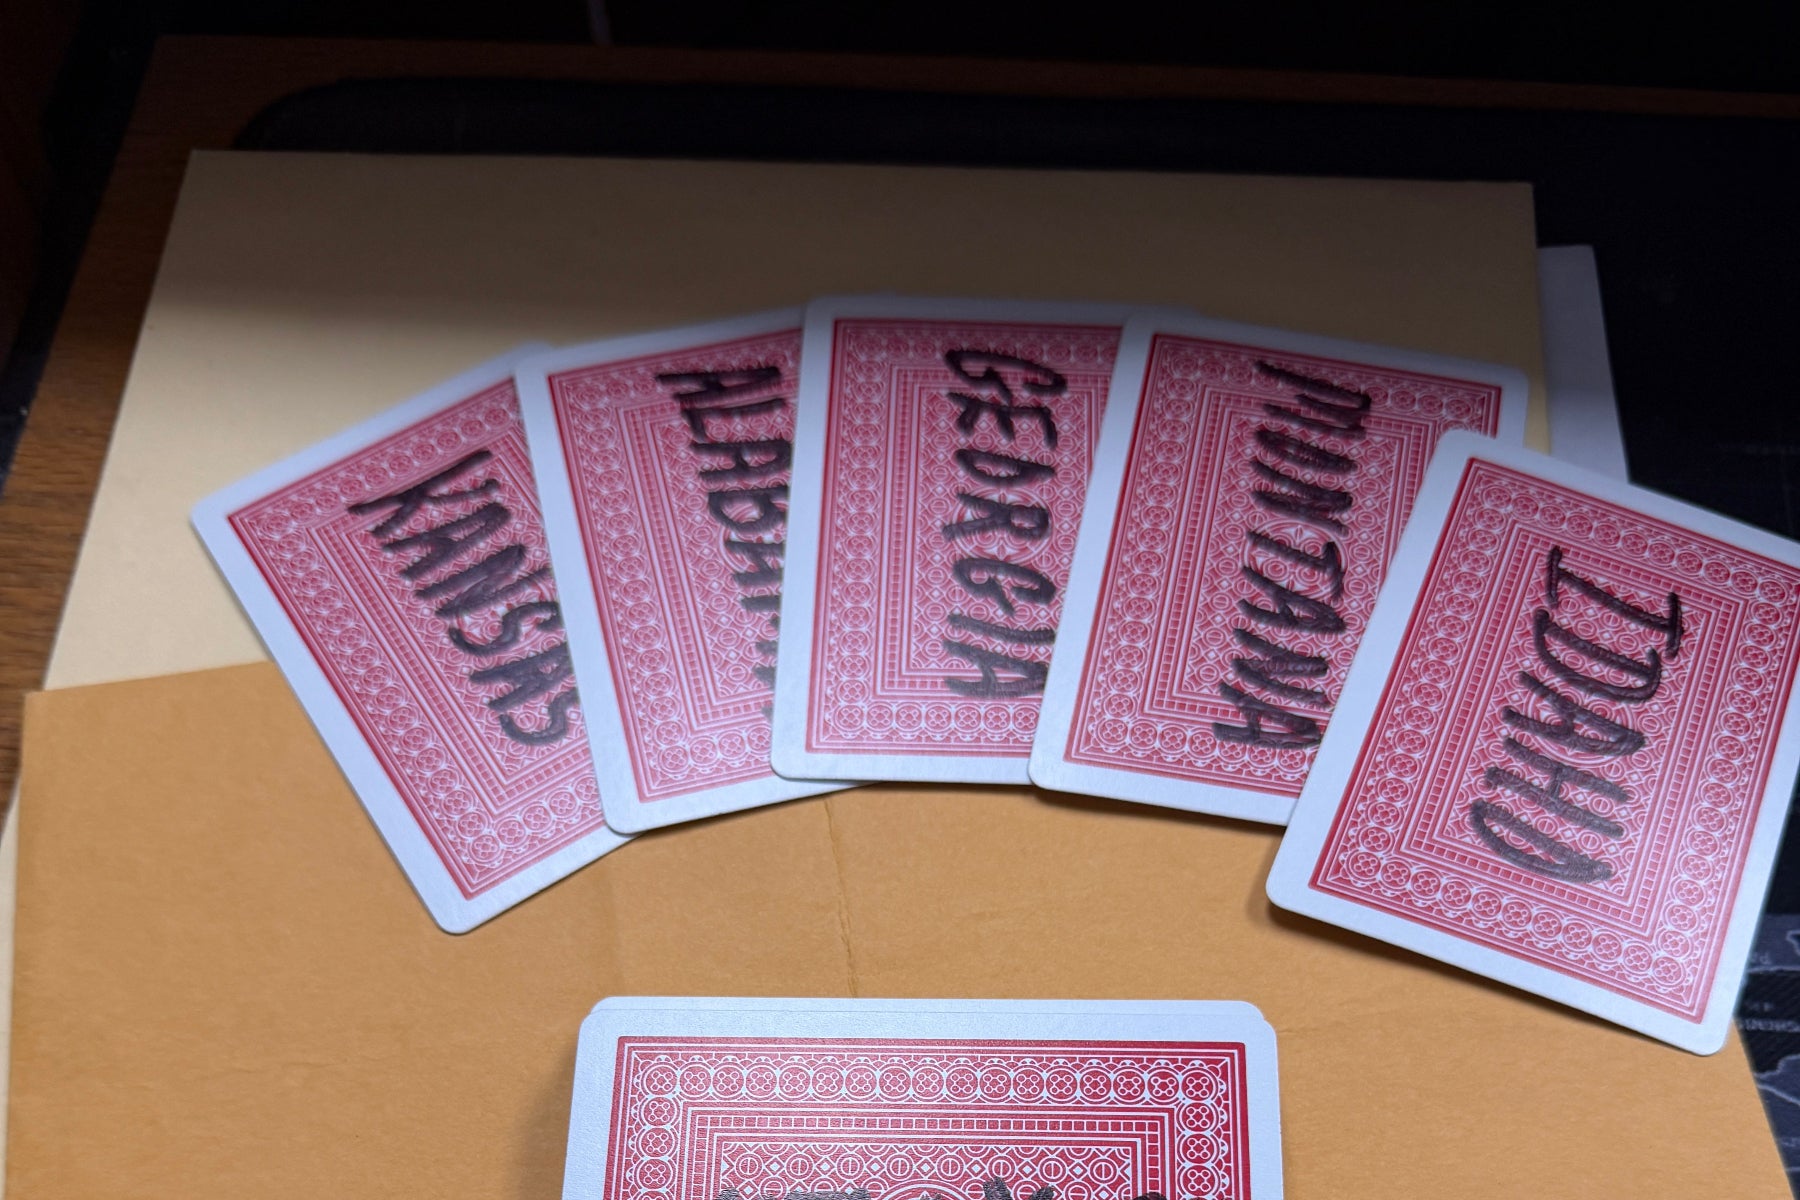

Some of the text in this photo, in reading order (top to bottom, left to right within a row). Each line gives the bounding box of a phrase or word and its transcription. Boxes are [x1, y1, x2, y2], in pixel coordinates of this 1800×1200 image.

[347, 448, 581, 748] KANSAS
[655, 366, 795, 723] ALABA
[942, 347, 1068, 703] GEORGIA
[1211, 359, 1374, 750] MONTANA
[1468, 545, 1684, 886] IDAHO
